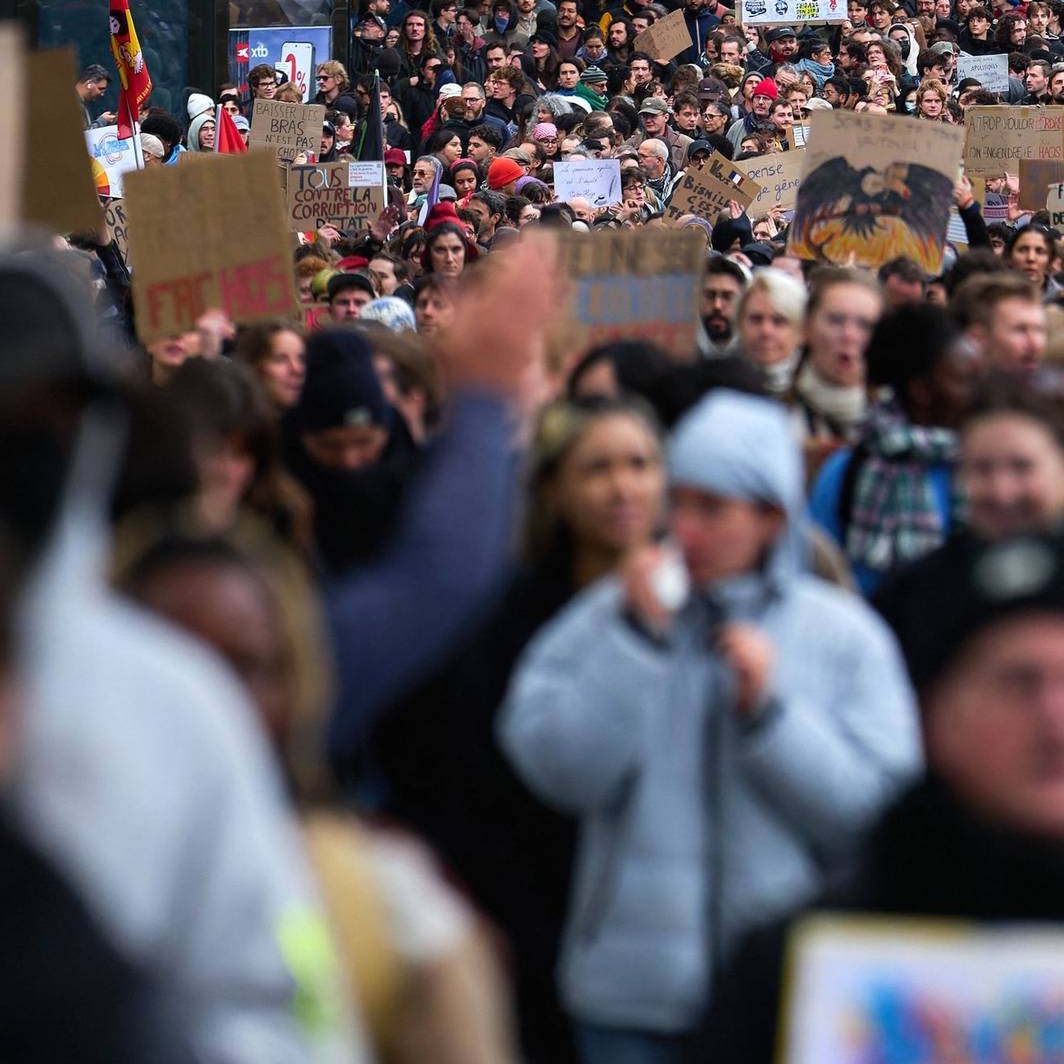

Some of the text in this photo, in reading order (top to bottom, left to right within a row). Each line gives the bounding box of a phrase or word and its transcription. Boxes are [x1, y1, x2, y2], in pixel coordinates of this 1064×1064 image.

[250, 46, 269, 58] xtb
[256, 103, 318, 121] BAISSER LES
[270, 118, 305, 136] BRAS
[977, 116, 1000, 131] TROP
[265, 134, 314, 148] N'EST PAS
[970, 147, 981, 159] ON
[982, 146, 1022, 159] ENGENDRE
[291, 166, 343, 190] TOUS
[295, 187, 371, 203] CONTRE LA
[292, 202, 377, 220] CORRUPTION
